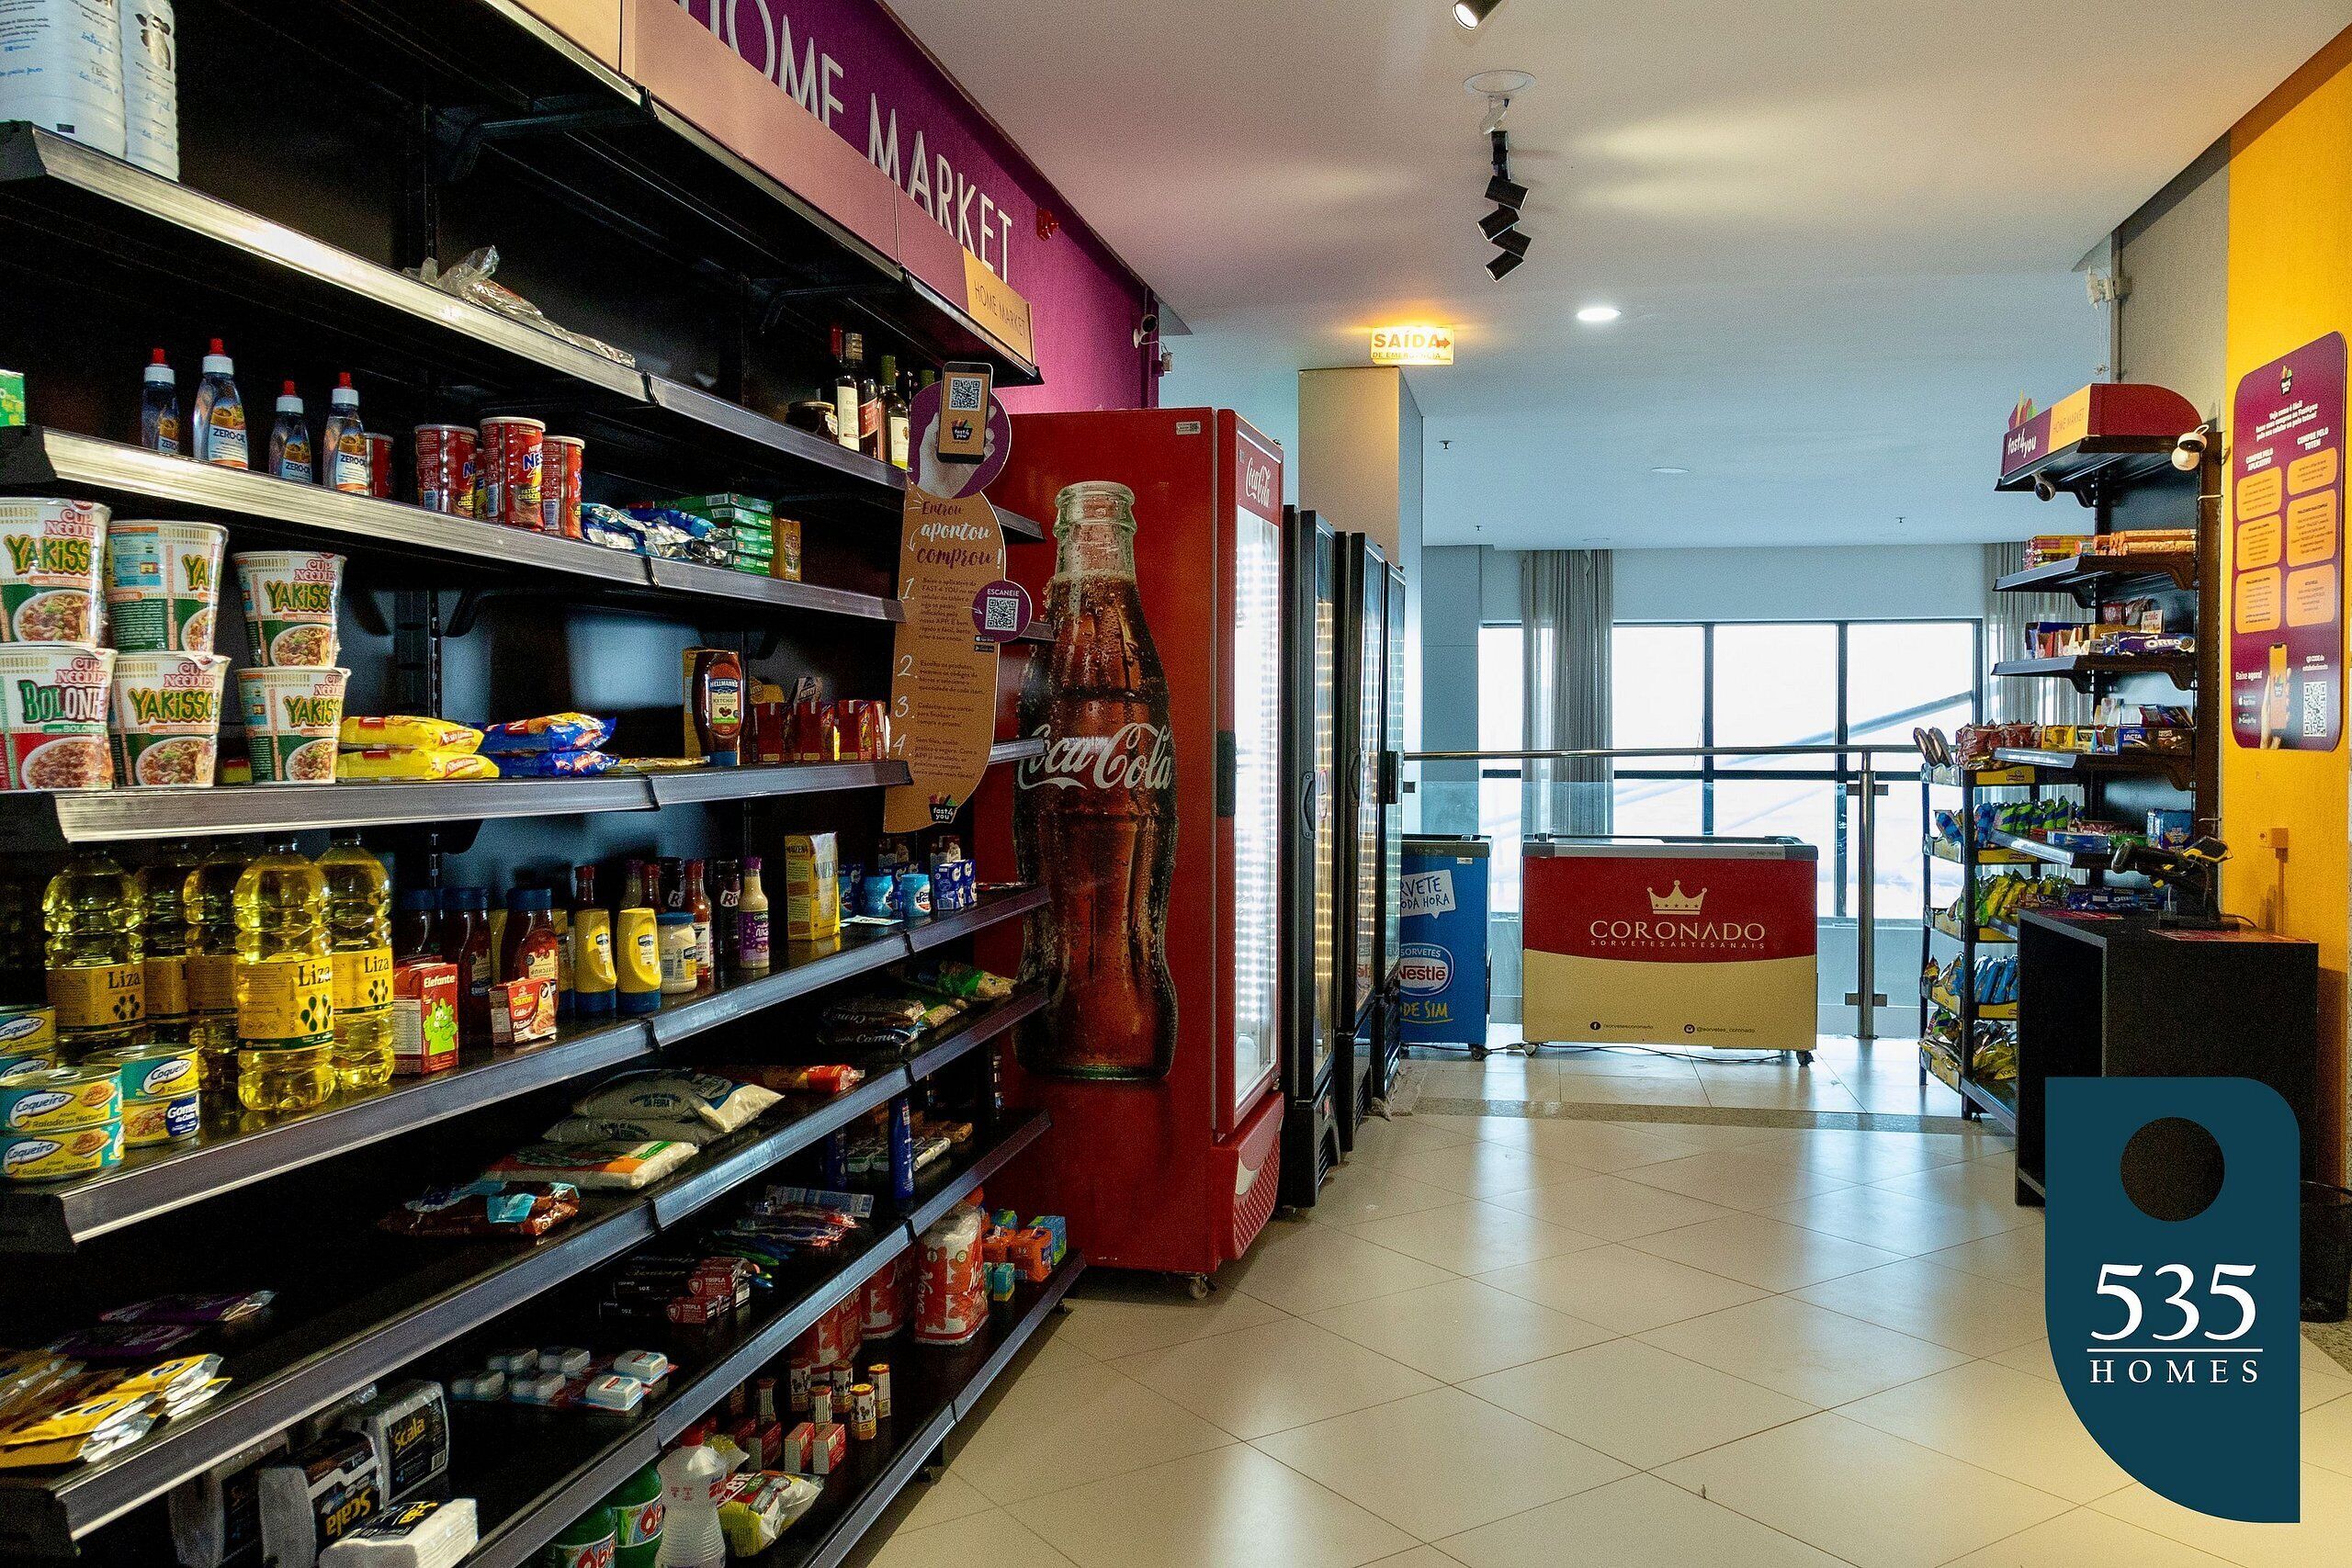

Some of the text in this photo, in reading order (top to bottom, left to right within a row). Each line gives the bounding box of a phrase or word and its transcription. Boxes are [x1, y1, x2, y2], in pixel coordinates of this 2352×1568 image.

[679, 0, 1012, 285] OME MARKET
[975, 281, 1027, 339] HOME MARKET
[1374, 331, 1440, 348] SAÍDA
[921, 501, 963, 515] Entrou
[920, 521, 993, 543] apontou
[987, 588, 1020, 597] ESCANEIE
[2146, 638, 2182, 649] OREO
[72, 658, 102, 671] CUP
[1422, 893, 1450, 907] HORA
[1589, 920, 1766, 942] CORONADO
[1401, 946, 1442, 958] SORVETES
[364, 955, 389, 974] Liza
[107, 970, 141, 989] Liza
[298, 964, 332, 987] Liza
[424, 974, 456, 988] Elefante
[15, 1093, 67, 1114] Coqueiro
[7, 1143, 54, 1160] Coqueiro
[394, 1418, 425, 1453] Scala
